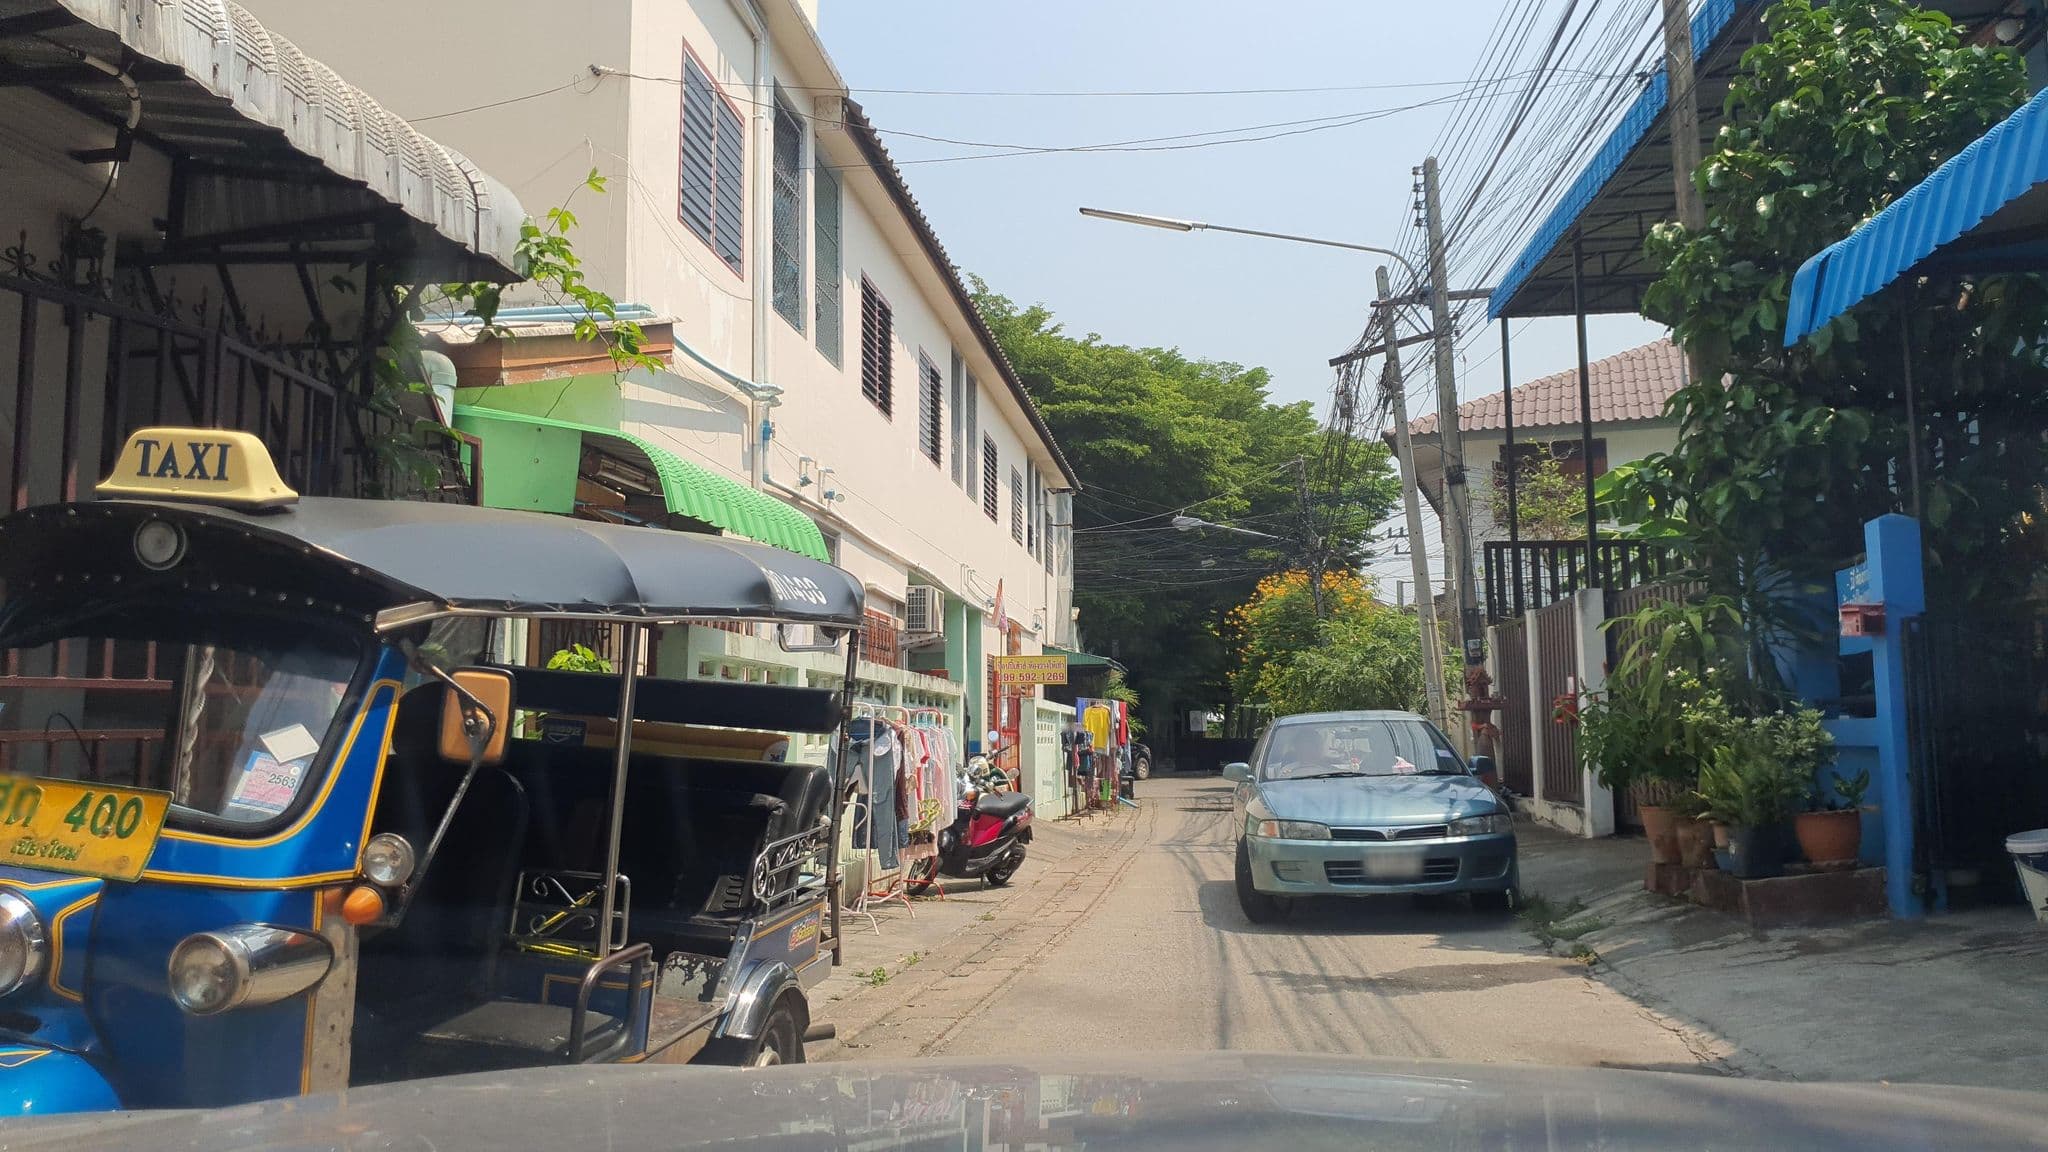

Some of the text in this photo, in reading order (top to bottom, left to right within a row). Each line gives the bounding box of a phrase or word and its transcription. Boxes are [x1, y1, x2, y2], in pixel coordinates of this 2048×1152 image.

[134, 439, 232, 481] TAXI
[267, 773, 296, 789] 2563
[64, 790, 144, 840] 400
